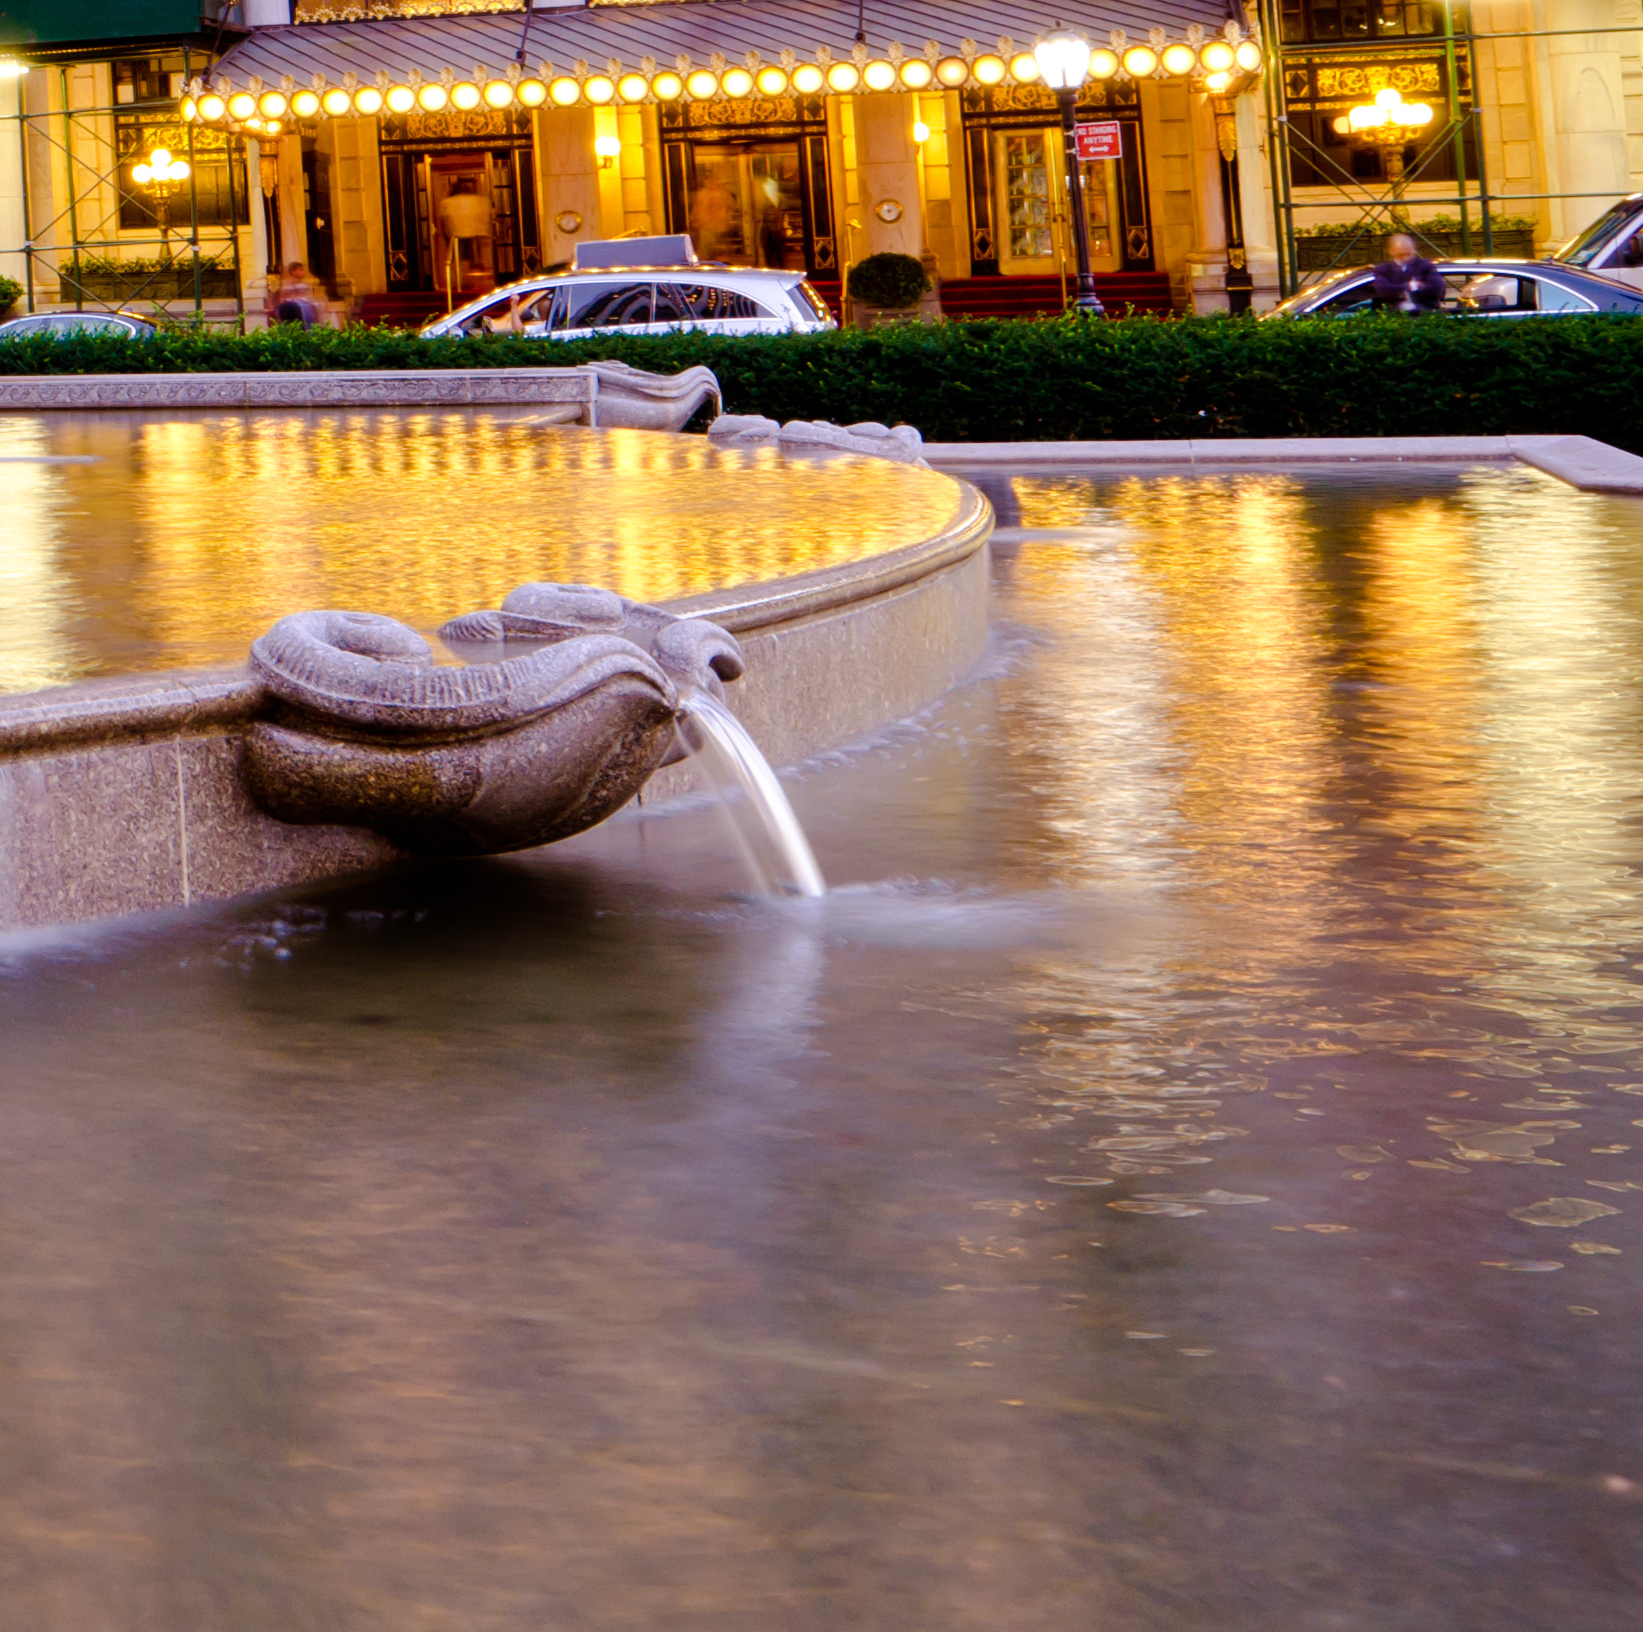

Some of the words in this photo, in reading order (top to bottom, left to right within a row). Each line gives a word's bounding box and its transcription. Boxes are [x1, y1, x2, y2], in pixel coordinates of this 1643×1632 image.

[1076, 127, 1087, 135] NO
[1088, 125, 1117, 135] STANDING
[1083, 135, 1113, 144] ANYTIME
